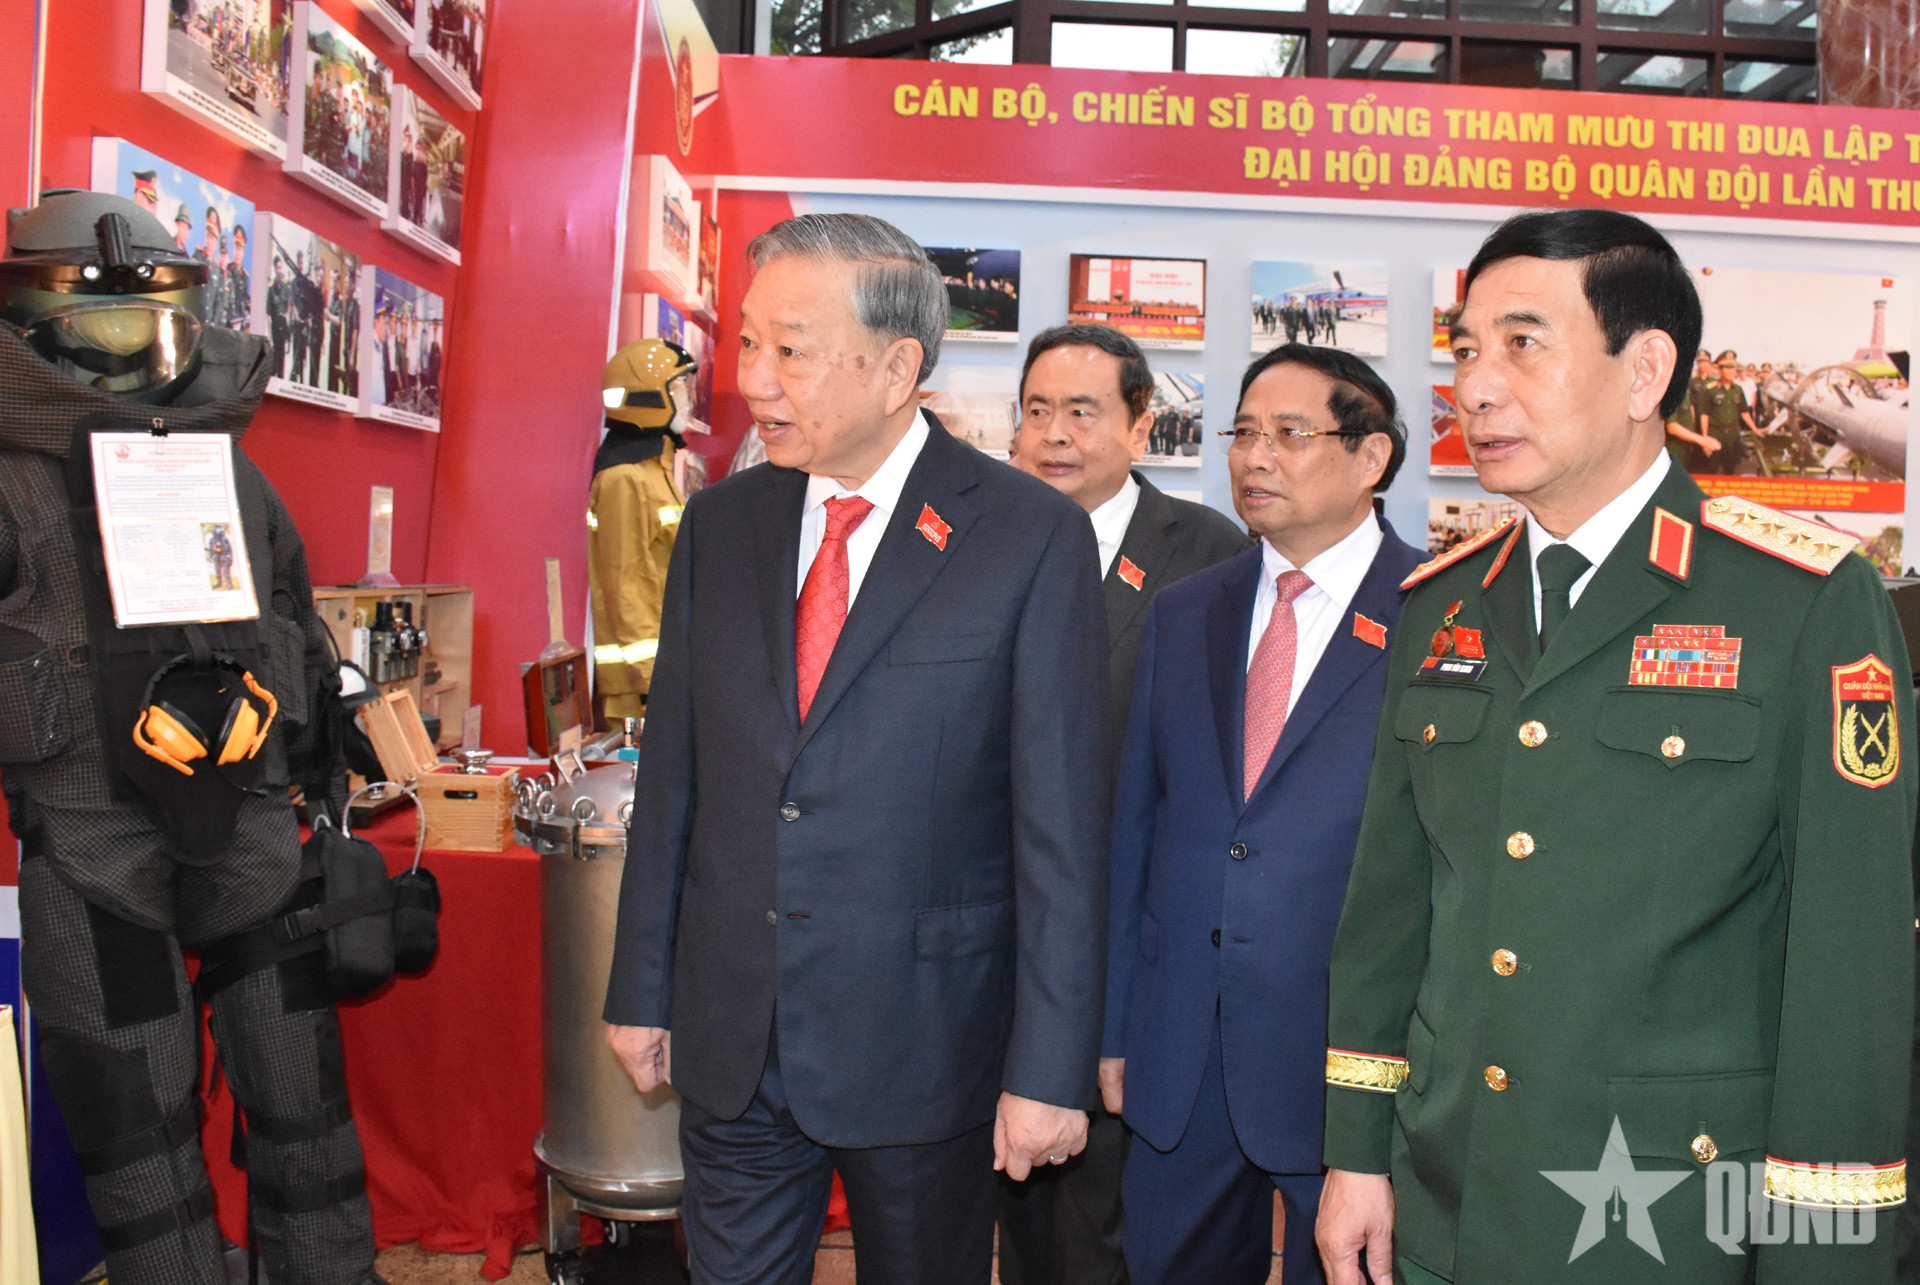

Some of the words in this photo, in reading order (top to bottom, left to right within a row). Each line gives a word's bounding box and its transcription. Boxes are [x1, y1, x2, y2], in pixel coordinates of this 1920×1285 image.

[894, 79, 979, 117] CÁN
[992, 83, 1058, 126] BỘ,
[1073, 86, 1195, 126] CHIẾN
[1208, 93, 1249, 129] SĨ
[1262, 95, 1314, 137] BỘ
[1327, 94, 1431, 137] TỔNG
[1444, 109, 1554, 144] THAM
[1567, 114, 1655, 149] MƯU
[1666, 120, 1725, 153] THI
[1737, 124, 1811, 158] ĐUA
[1823, 124, 1894, 166] LẬP
[1243, 146, 1311, 188] ĐẠI
[1325, 145, 1391, 191] HỘI
[1403, 145, 1512, 191] ĐẢNG
[1525, 154, 1577, 200] BỘ
[1589, 159, 1695, 199] QUÂN
[1706, 164, 1770, 210] ĐỘI
[1782, 163, 1856, 208] LẦN
